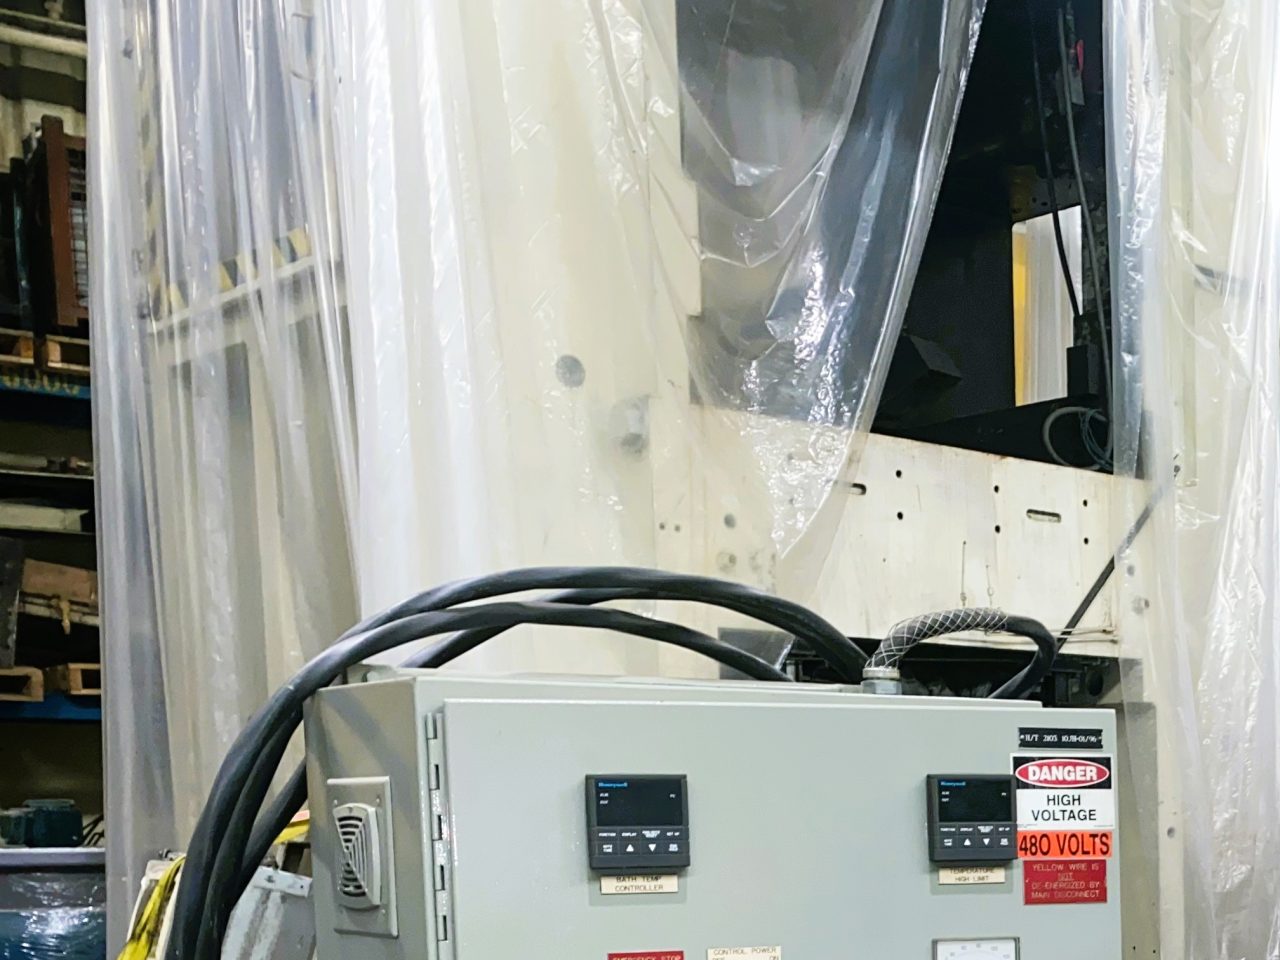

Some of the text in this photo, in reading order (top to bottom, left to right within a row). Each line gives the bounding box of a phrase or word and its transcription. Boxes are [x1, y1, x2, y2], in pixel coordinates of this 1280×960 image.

[1027, 766, 1098, 781] DANGER
[1046, 794, 1081, 806] HIGH
[1031, 809, 1097, 822] VOLTAGE
[1019, 832, 1110, 856] 480 VOLTS
[1033, 863, 1099, 872] YELLOW WIRE IS
[615, 875, 637, 883] BATH
[614, 884, 664, 892] CONTROLLER
[1089, 881, 1100, 889] BY
